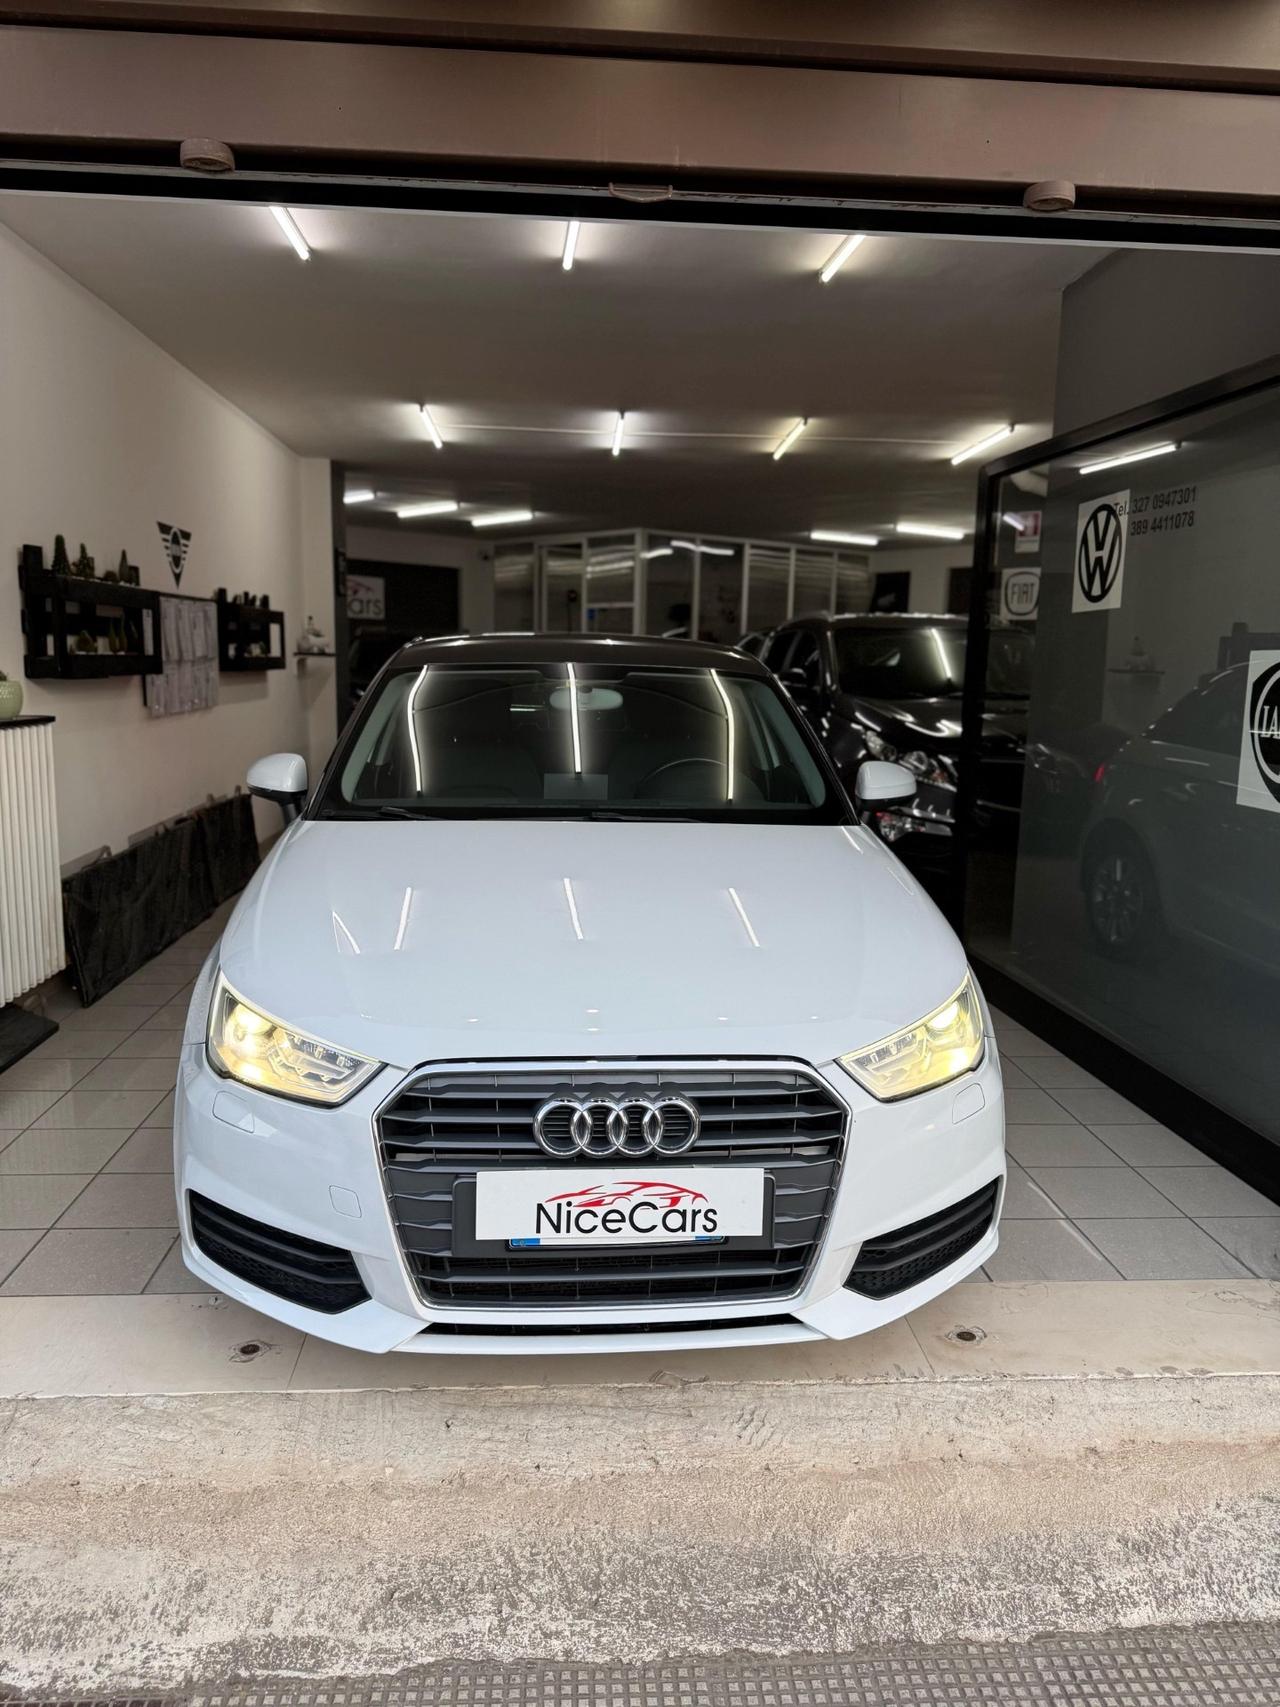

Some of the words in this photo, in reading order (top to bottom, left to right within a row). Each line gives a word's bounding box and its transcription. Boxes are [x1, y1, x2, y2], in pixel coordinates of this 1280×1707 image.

[1132, 496, 1150, 514] 327
[1152, 486, 1197, 511] 0947301
[1130, 519, 1149, 536] 389
[1150, 511, 1196, 533] 4411078
[1011, 583, 1035, 605] FIAT
[1260, 705, 1280, 739] LA
[535, 1201, 718, 1235] NiceCars
